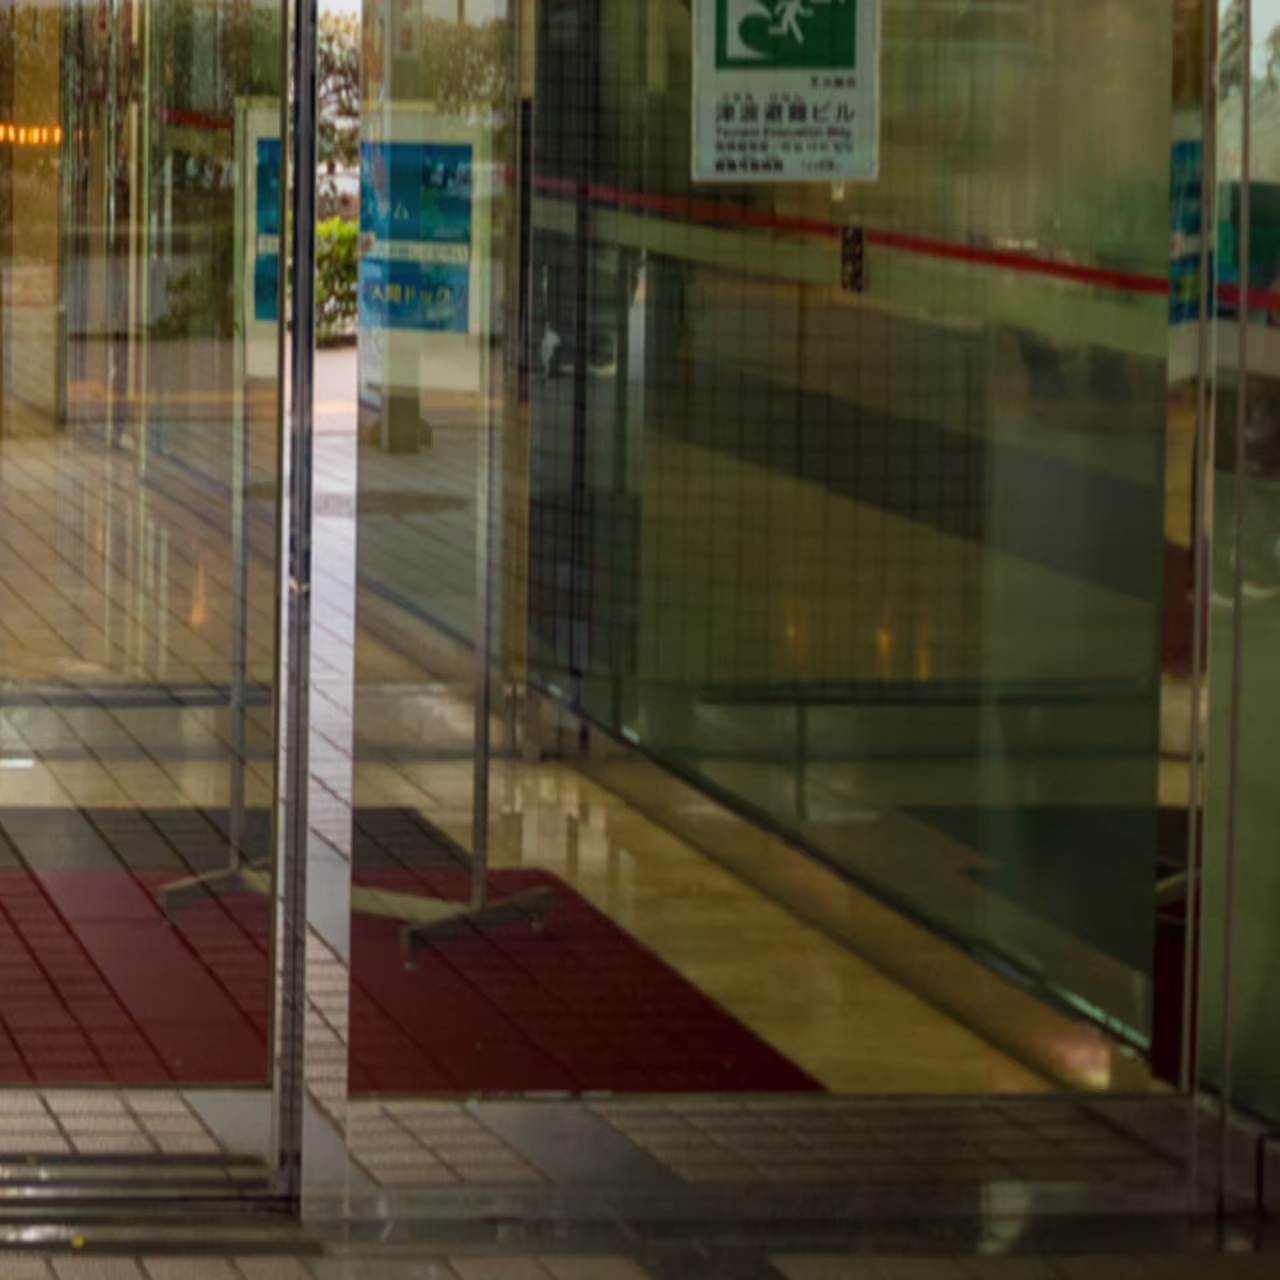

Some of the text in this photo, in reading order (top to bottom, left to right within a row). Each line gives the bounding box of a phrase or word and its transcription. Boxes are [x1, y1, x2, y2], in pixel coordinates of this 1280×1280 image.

[716, 102, 855, 123] 津波避難ビル
